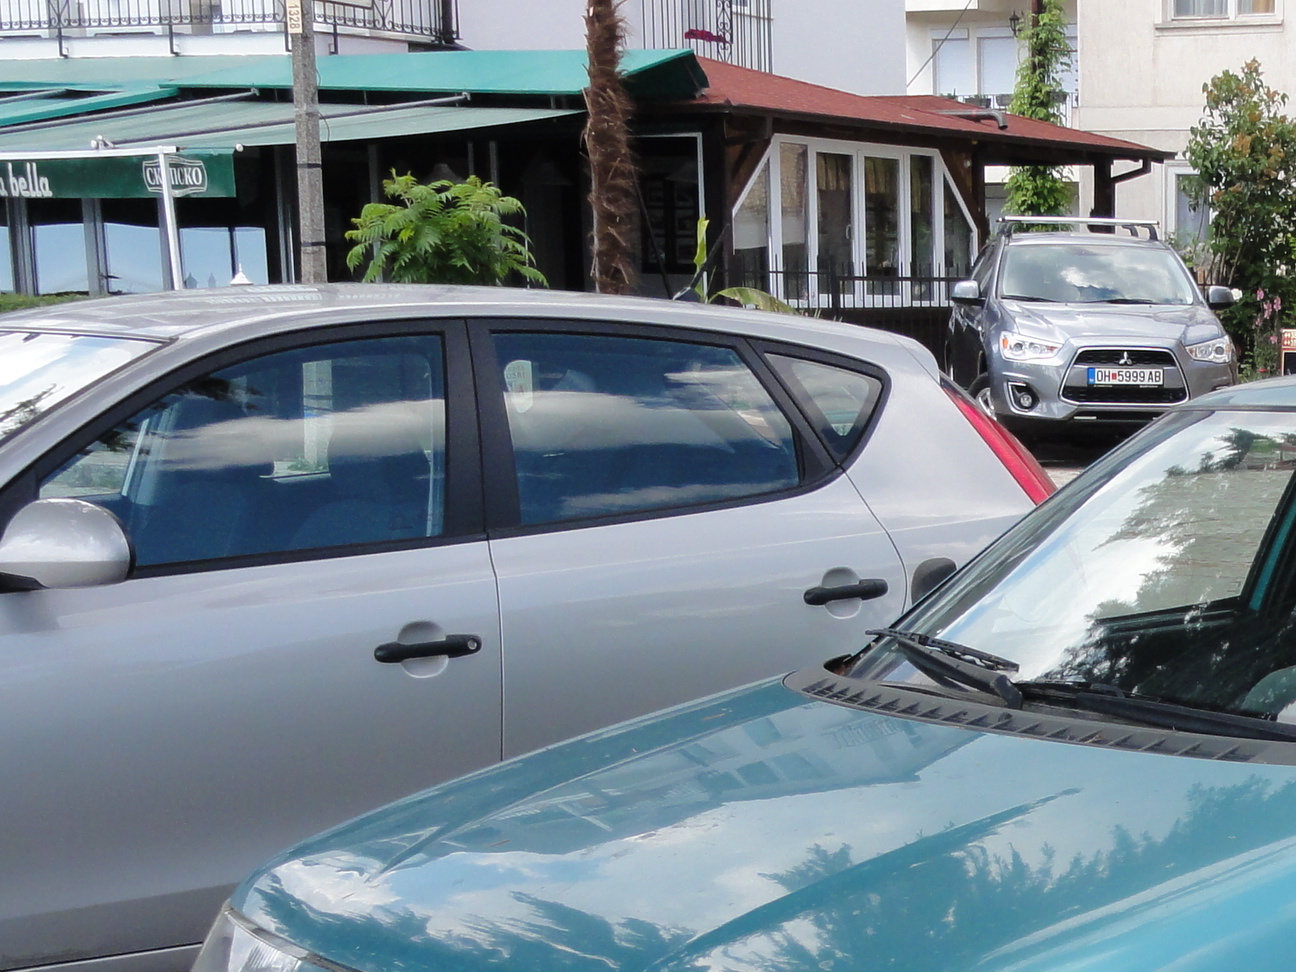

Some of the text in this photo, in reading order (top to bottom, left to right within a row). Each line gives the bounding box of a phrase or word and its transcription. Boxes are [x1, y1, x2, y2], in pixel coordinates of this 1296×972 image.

[288, 4, 300, 29] 1328
[8, 162, 53, 197] bella
[146, 167, 203, 185] СКПСКО
[1096, 370, 1161, 383] OH 5999 AB
